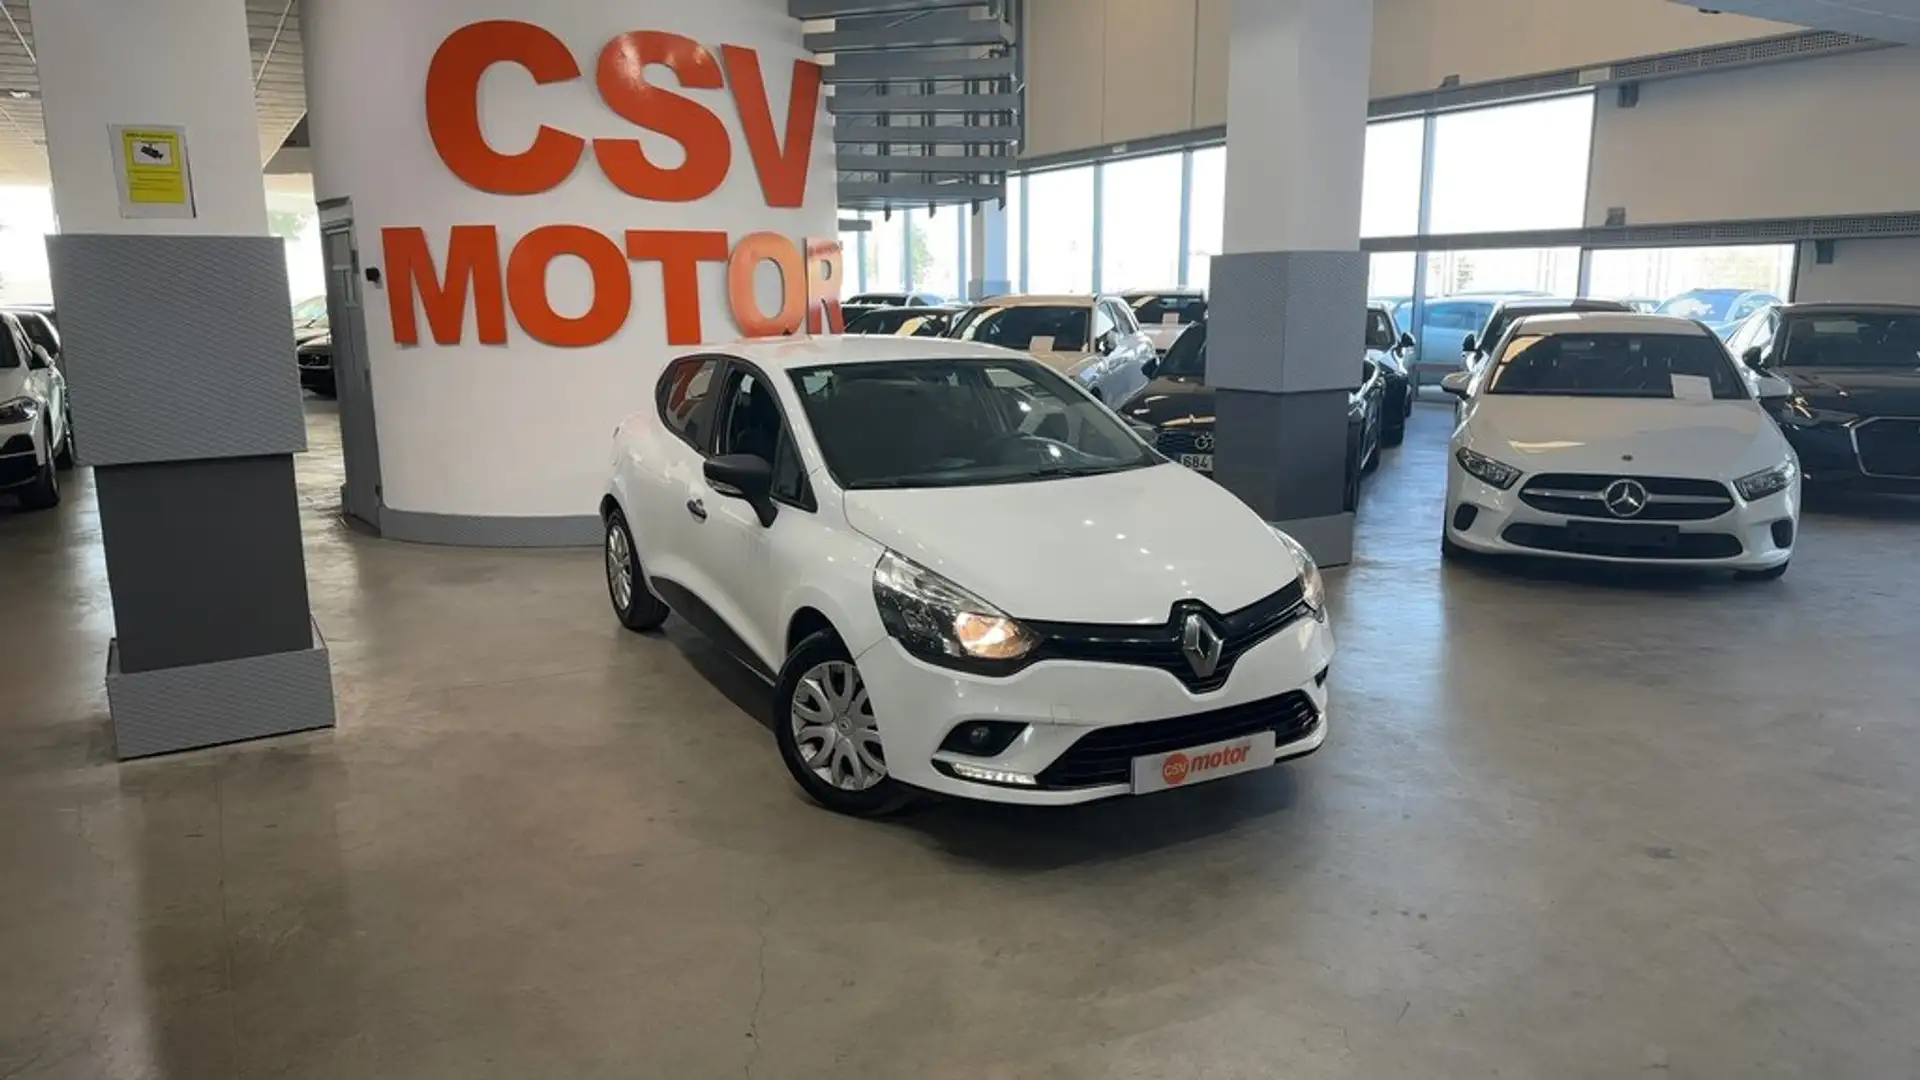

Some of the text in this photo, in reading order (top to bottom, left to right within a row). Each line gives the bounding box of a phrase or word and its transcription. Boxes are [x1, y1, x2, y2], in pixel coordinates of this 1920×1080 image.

[425, 19, 822, 208] CSV
[381, 224, 845, 348] MOTOR
[1191, 745, 1251, 773] motor
